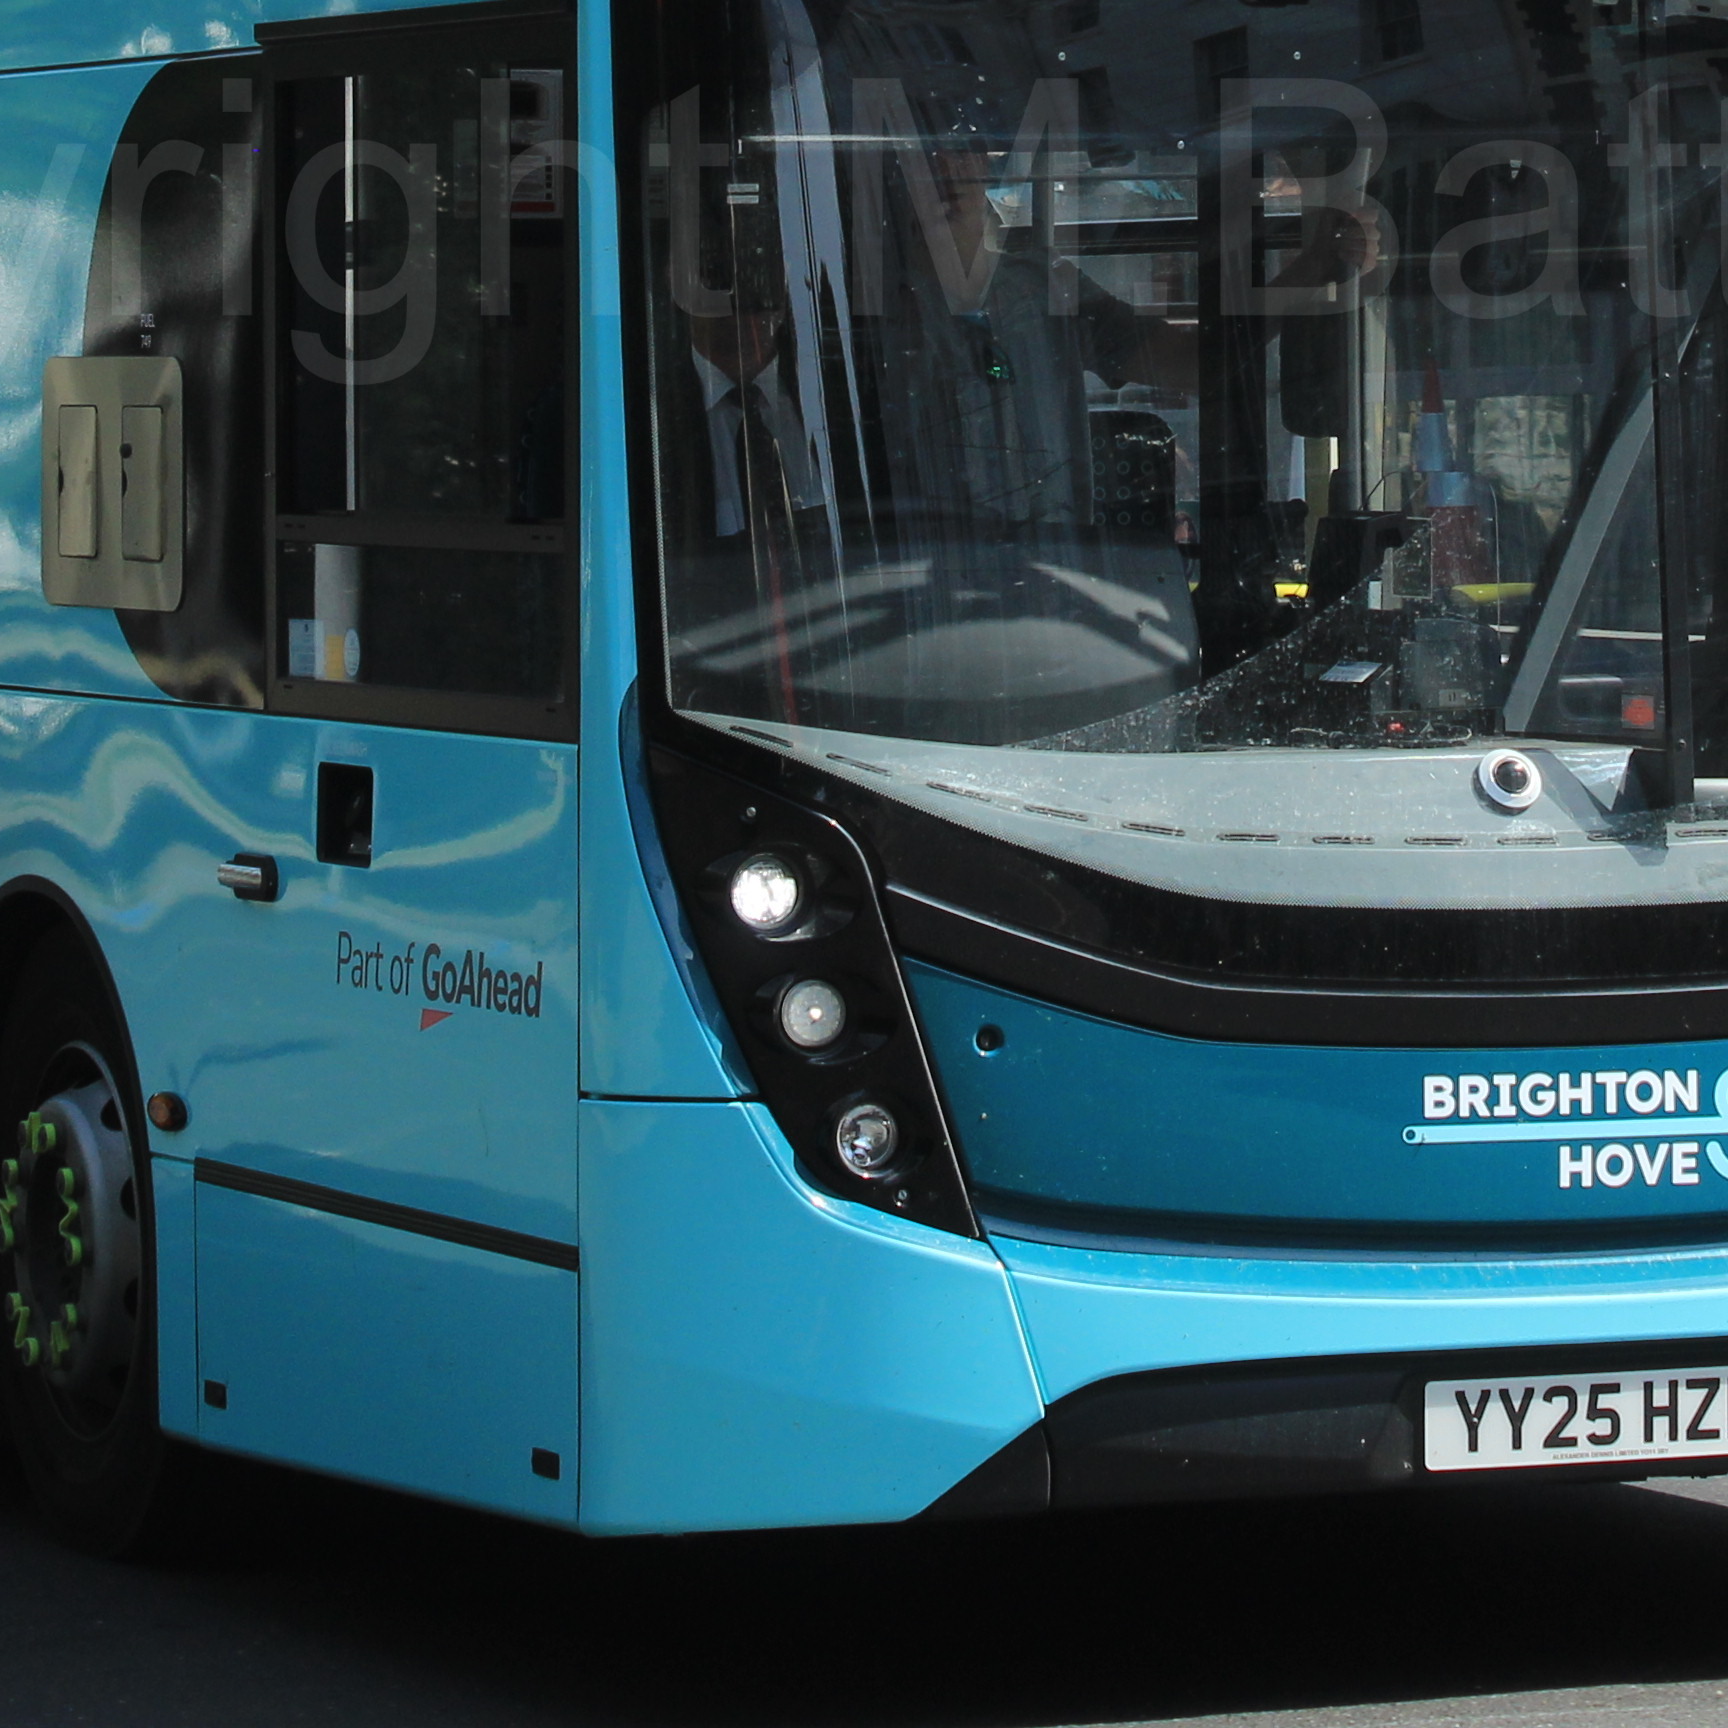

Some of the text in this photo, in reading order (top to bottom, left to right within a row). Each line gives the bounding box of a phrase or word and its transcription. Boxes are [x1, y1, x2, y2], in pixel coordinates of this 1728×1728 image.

[336, 931, 542, 1018] Part of GoAhead
[1423, 1069, 1699, 1120] BRIGHTON
[1558, 1142, 1699, 1189] HOVE
[1455, 1382, 1621, 1453] YY25
